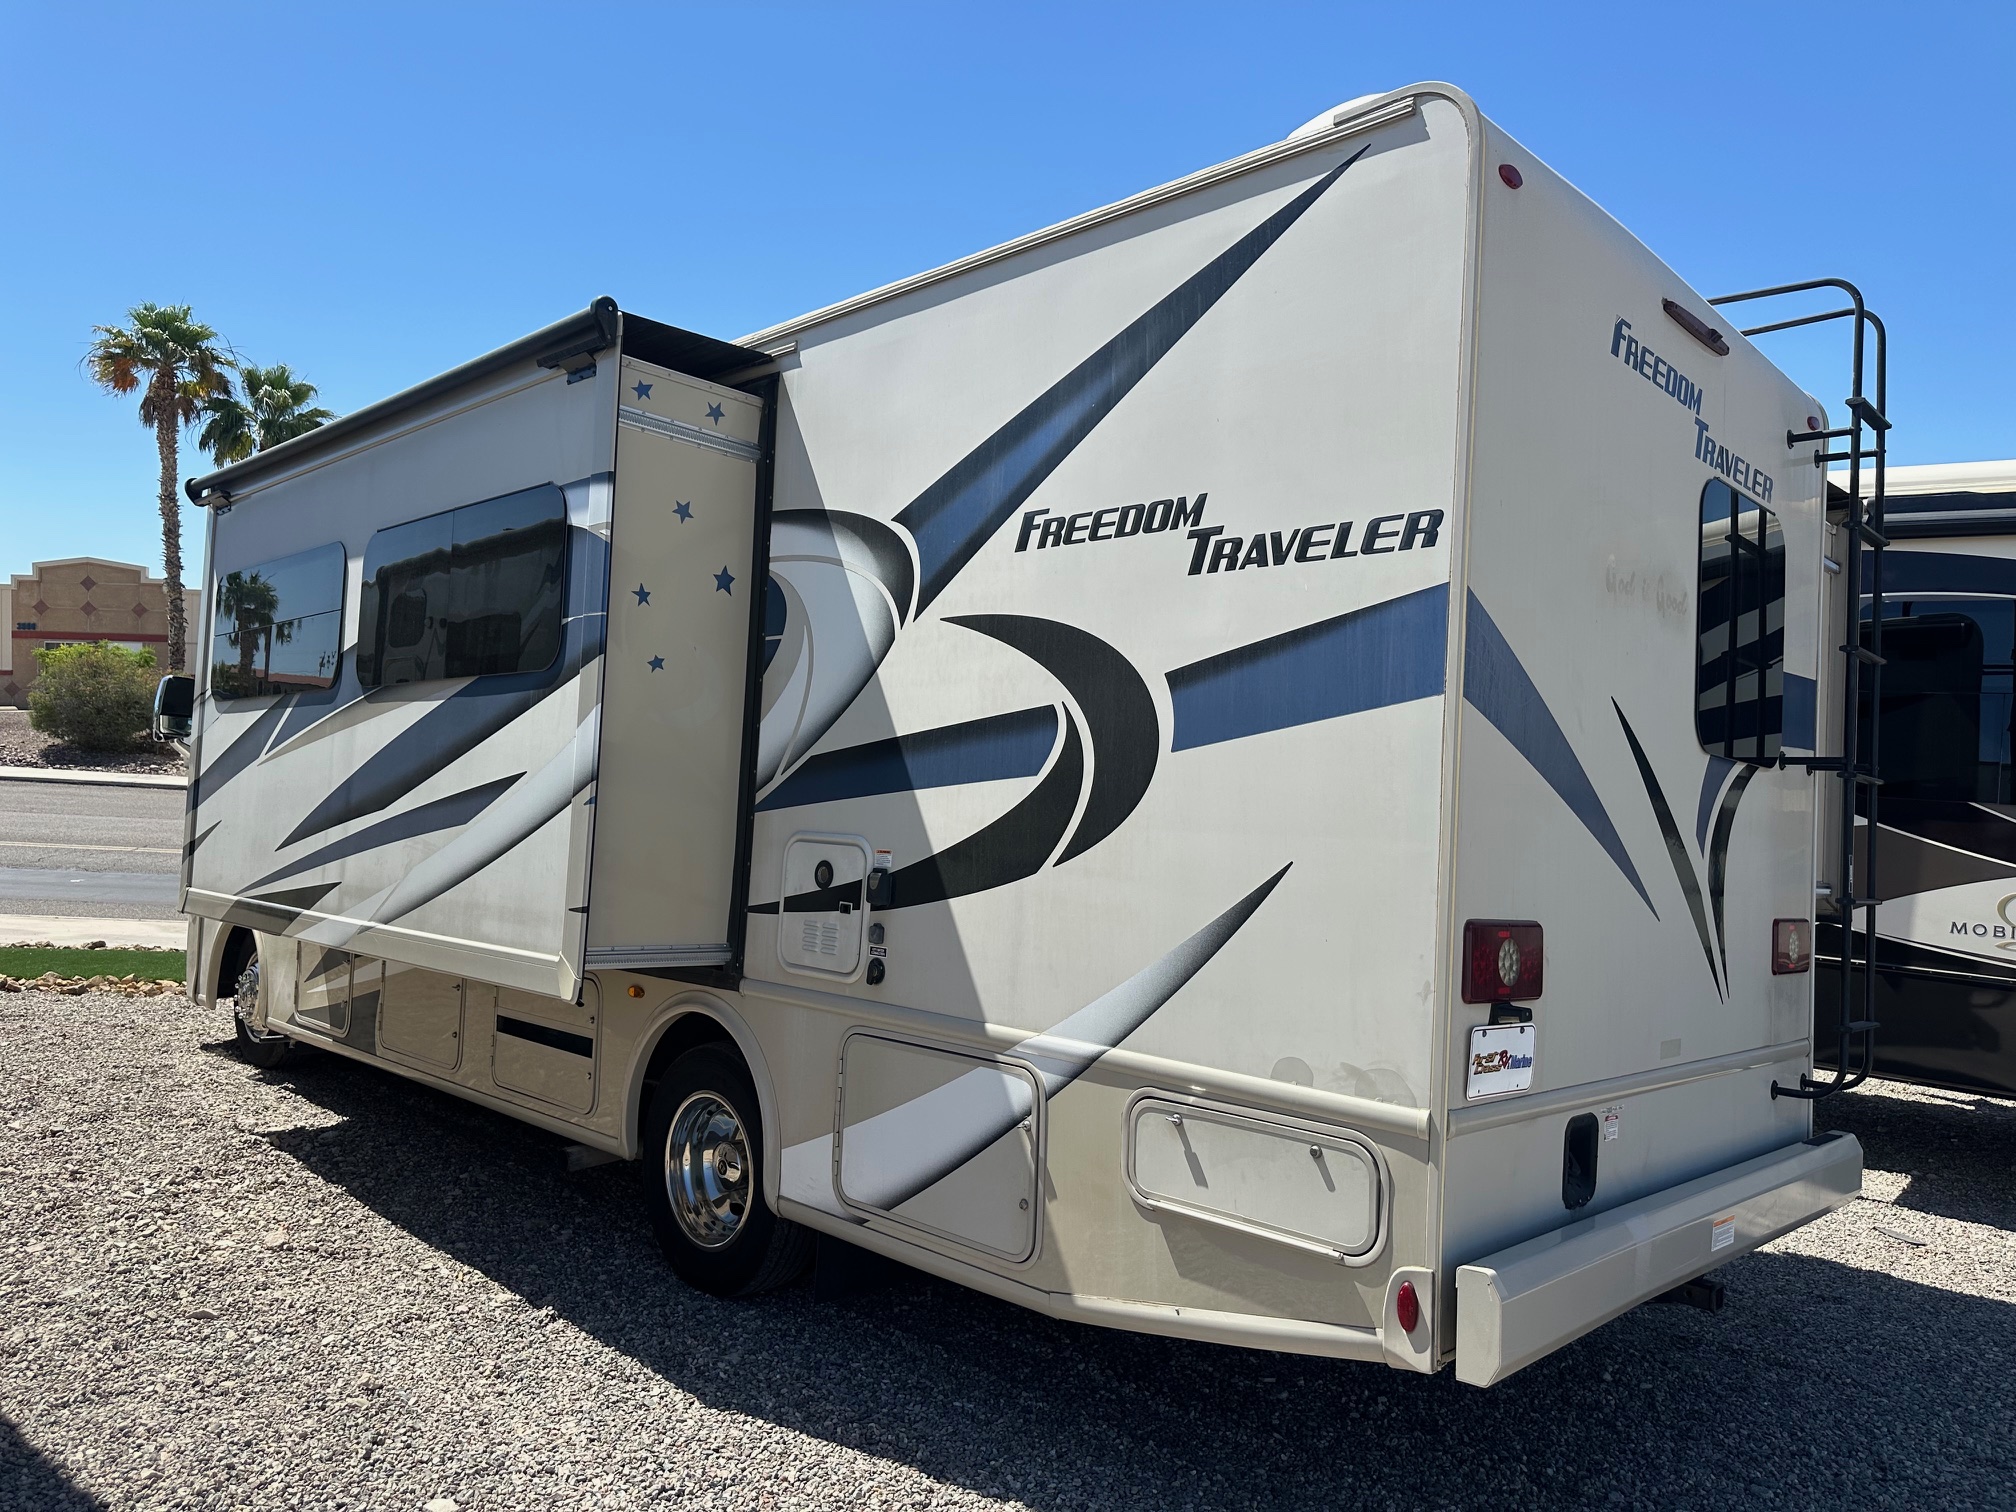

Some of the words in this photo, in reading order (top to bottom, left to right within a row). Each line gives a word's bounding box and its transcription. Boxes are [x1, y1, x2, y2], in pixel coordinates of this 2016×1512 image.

[1611, 316, 1703, 416] FREEDOM
[1694, 416, 1775, 504] TRAVELER
[1014, 492, 1208, 553] FREEDOM
[1186, 508, 1445, 576] TRAVELER
[1508, 1054, 1532, 1069] Marine
